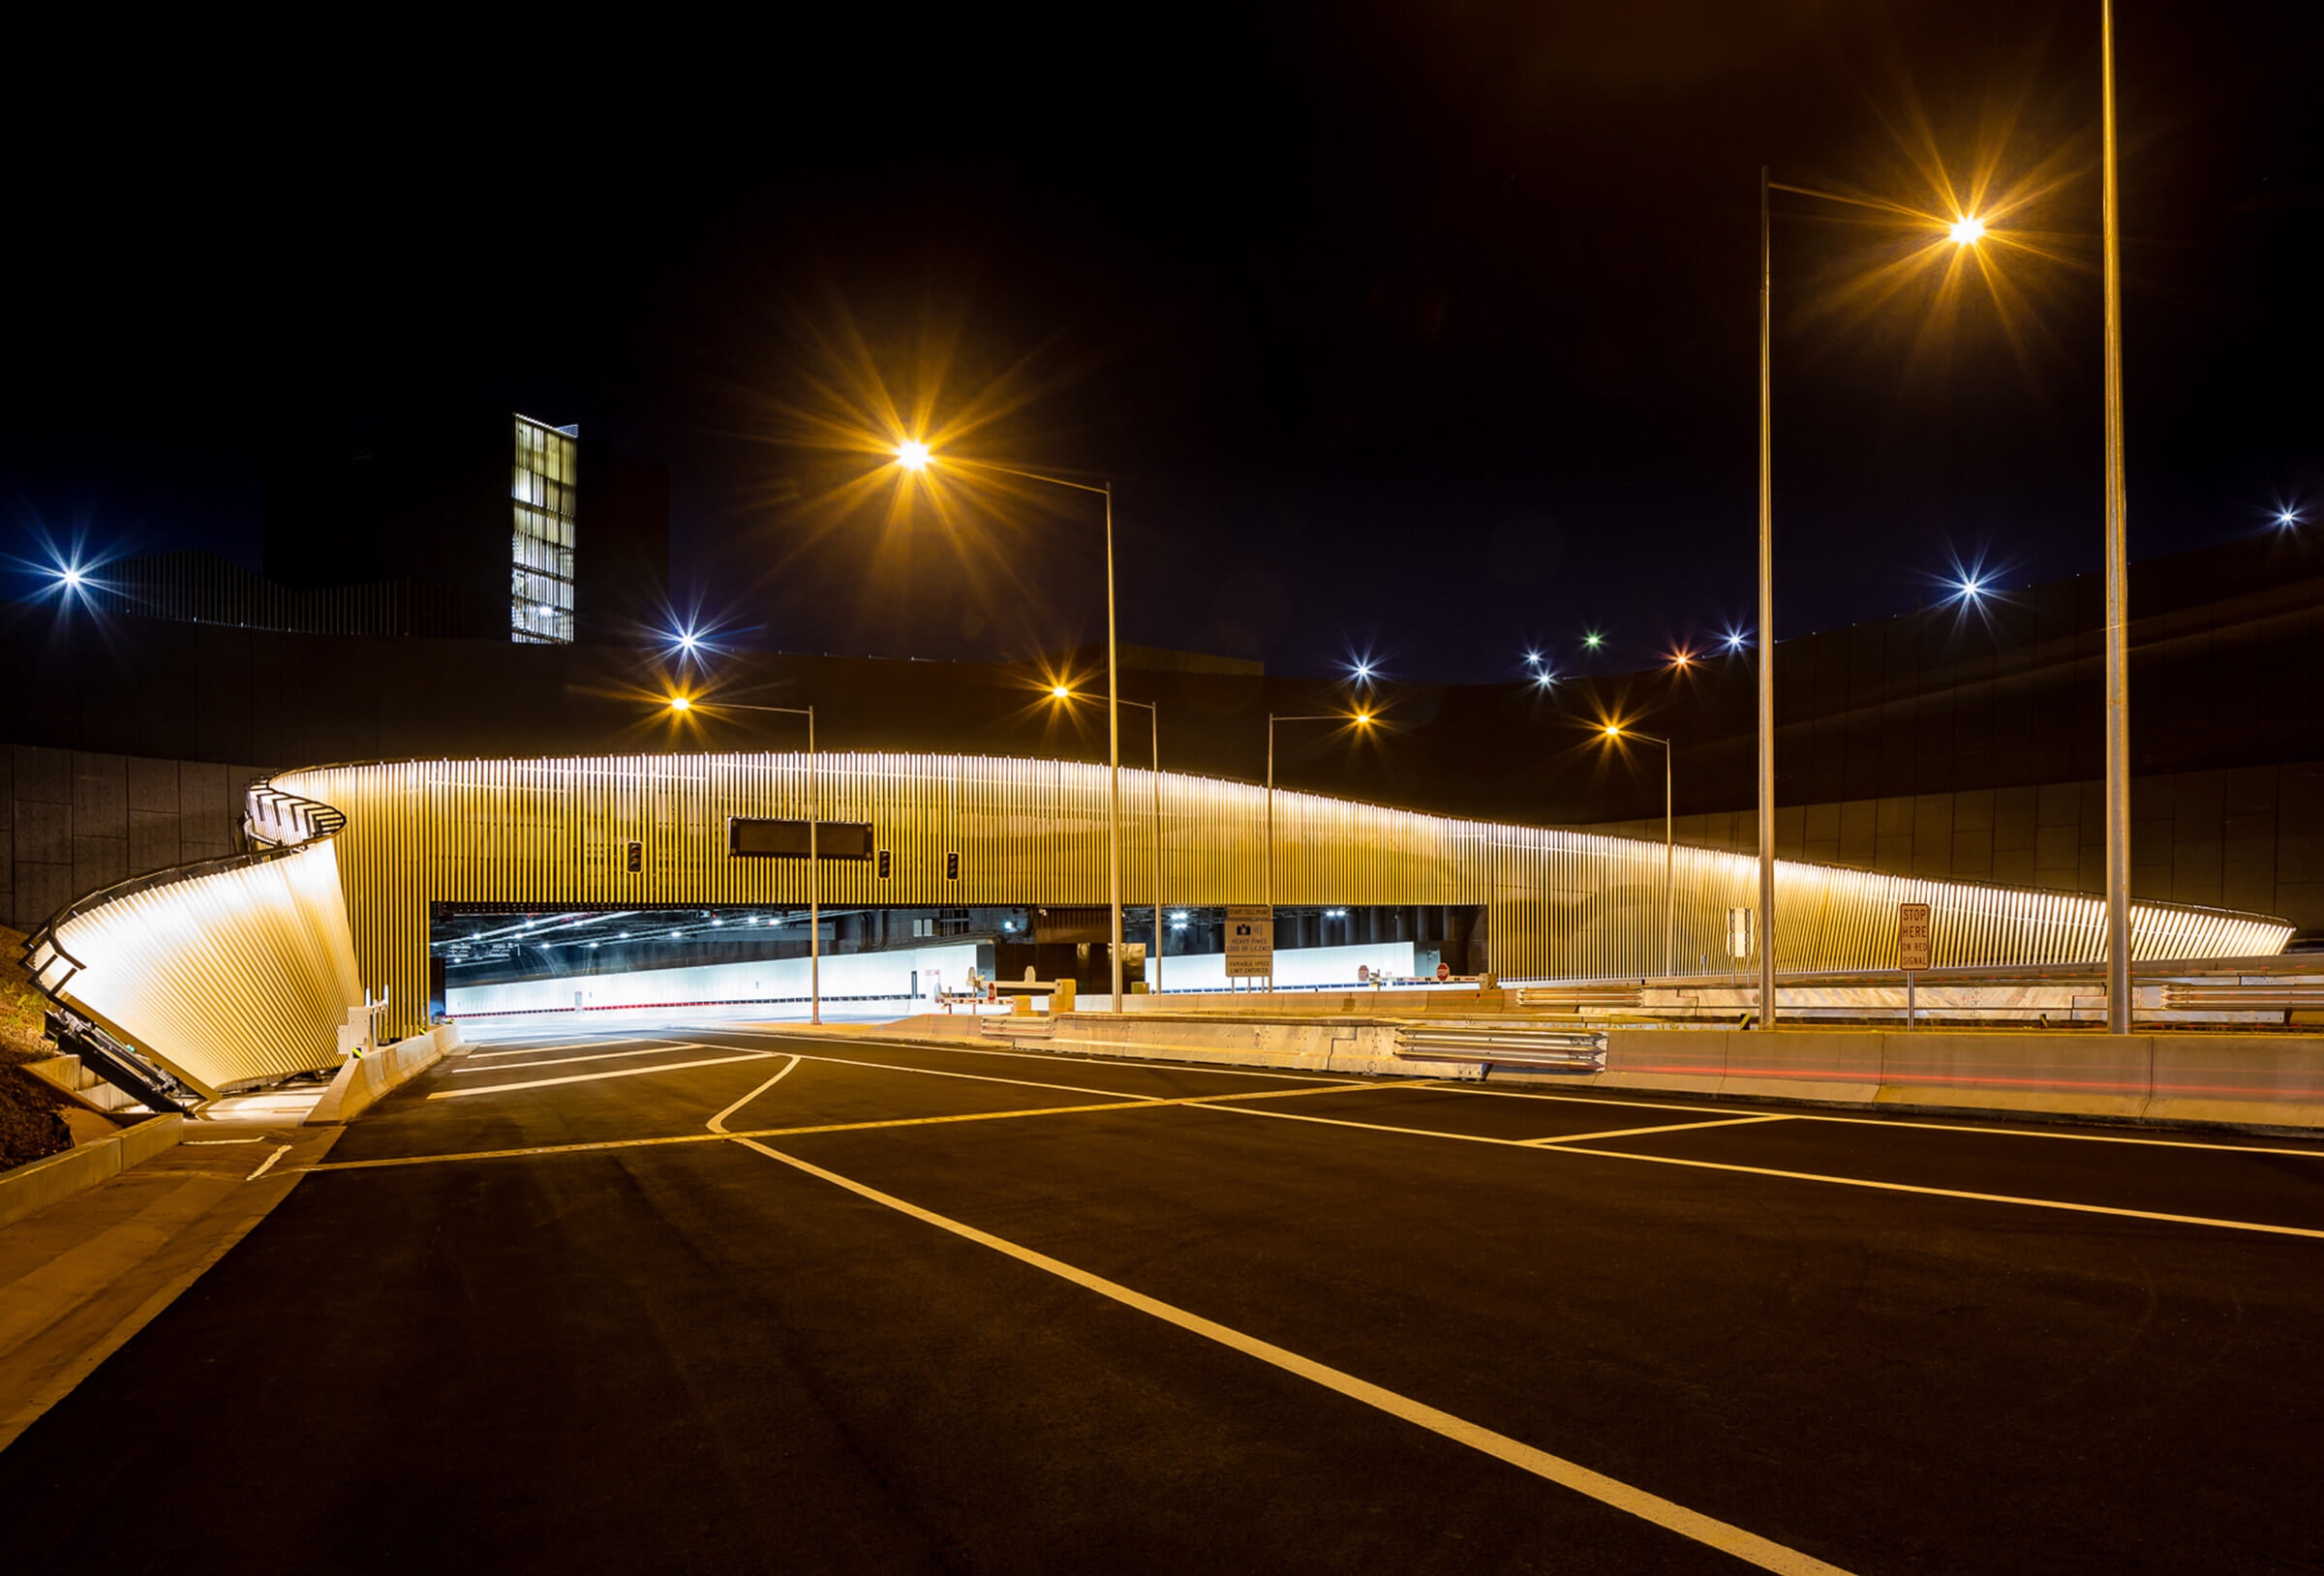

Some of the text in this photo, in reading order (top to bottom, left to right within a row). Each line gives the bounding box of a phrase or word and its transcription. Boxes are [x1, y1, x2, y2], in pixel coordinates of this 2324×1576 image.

[1904, 908, 1926, 921] STOP
[1903, 925, 1927, 938] HERE
[1903, 943, 1927, 952] ON RED
[1904, 955, 1926, 965] SIGNAL
